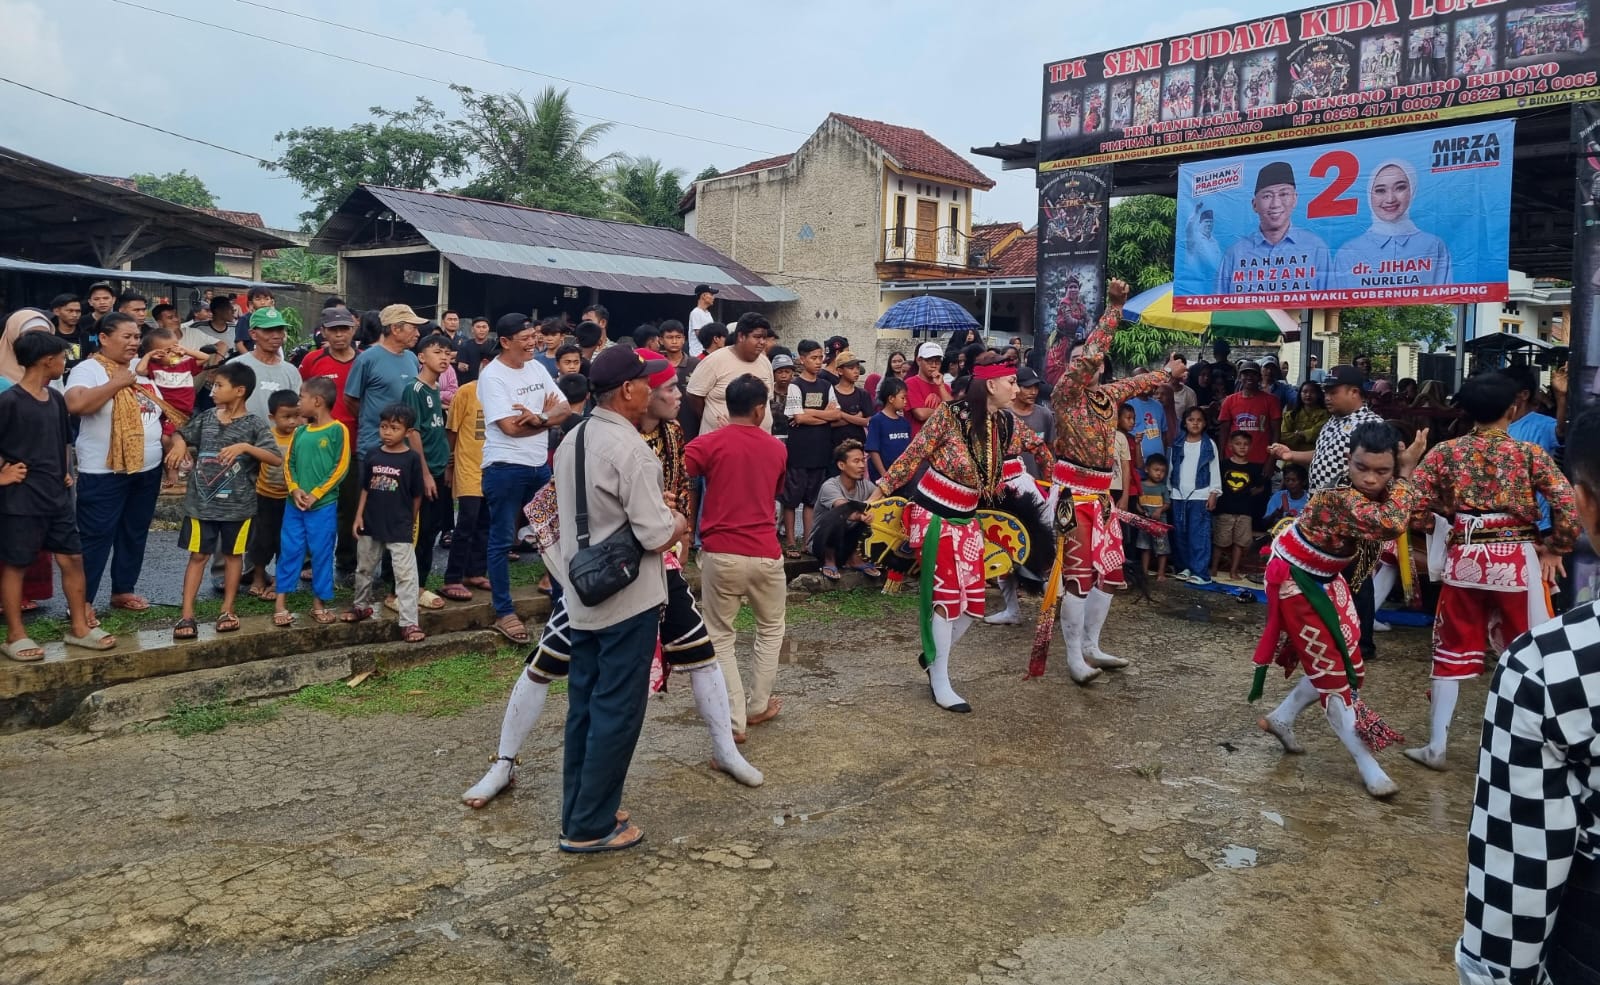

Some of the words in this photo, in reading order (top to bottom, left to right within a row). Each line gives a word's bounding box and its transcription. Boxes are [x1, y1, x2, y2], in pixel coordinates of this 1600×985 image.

[1049, 60, 1087, 83] TPK
[1104, 42, 1163, 78] SENI
[1168, 16, 1291, 66] BUDAYA
[1299, 0, 1400, 40] KUDA
[1122, 125, 1148, 138] TRI
[1152, 111, 1241, 132] MANUNGGAL
[1246, 101, 1298, 120] TIRTO
[1391, 78, 1461, 100] PUTRO
[1466, 61, 1560, 89] BUDOYO
[1529, 92, 1576, 105] BINMAS
[1100, 137, 1154, 153] PIMPINAN
[1163, 131, 1183, 144] EDI
[1185, 120, 1263, 141] FAJARYANTO
[1293, 113, 1312, 126] HP
[1323, 107, 1358, 122] 0858
[1362, 102, 1397, 117] 4171
[1402, 96, 1441, 112] 0009
[1459, 87, 1500, 103] 0822
[1505, 79, 1548, 96] 1514
[1551, 71, 1597, 90] 0005
[1052, 159, 1080, 168] ALAMAT
[1087, 155, 1112, 164] DUSUN
[1114, 150, 1148, 161] BANGUN
[1150, 146, 1170, 156] REJO
[1172, 145, 1193, 153] DESA
[1196, 140, 1225, 150] TEMPEL
[1229, 136, 1251, 145] REJO
[1277, 124, 1341, 139] KEDONDONG
[1371, 111, 1439, 128] PESAWARAN
[1432, 133, 1499, 153] MIRZA
[1432, 147, 1499, 167] JIHAN
[1195, 169, 1231, 183] PILIHAN
[1195, 175, 1239, 190] PRABOWO
[1307, 150, 1359, 219] 2
[1240, 254, 1308, 267] RAHMAT
[1352, 262, 1372, 274] dr.
[1378, 258, 1432, 273] JIHAN
[1233, 266, 1316, 282] MIRZANI
[1361, 275, 1420, 286] NURLELA
[1236, 281, 1311, 292] DJAUSAL
[1186, 296, 1221, 305] CALON
[1223, 294, 1280, 304] GUBERNUR
[1283, 293, 1307, 302] DAN
[1310, 292, 1348, 302] WAKIL
[1352, 288, 1420, 299] GUBERNUR
[1423, 285, 1488, 297] LAMPUNG
[426, 395, 433, 408] 9
